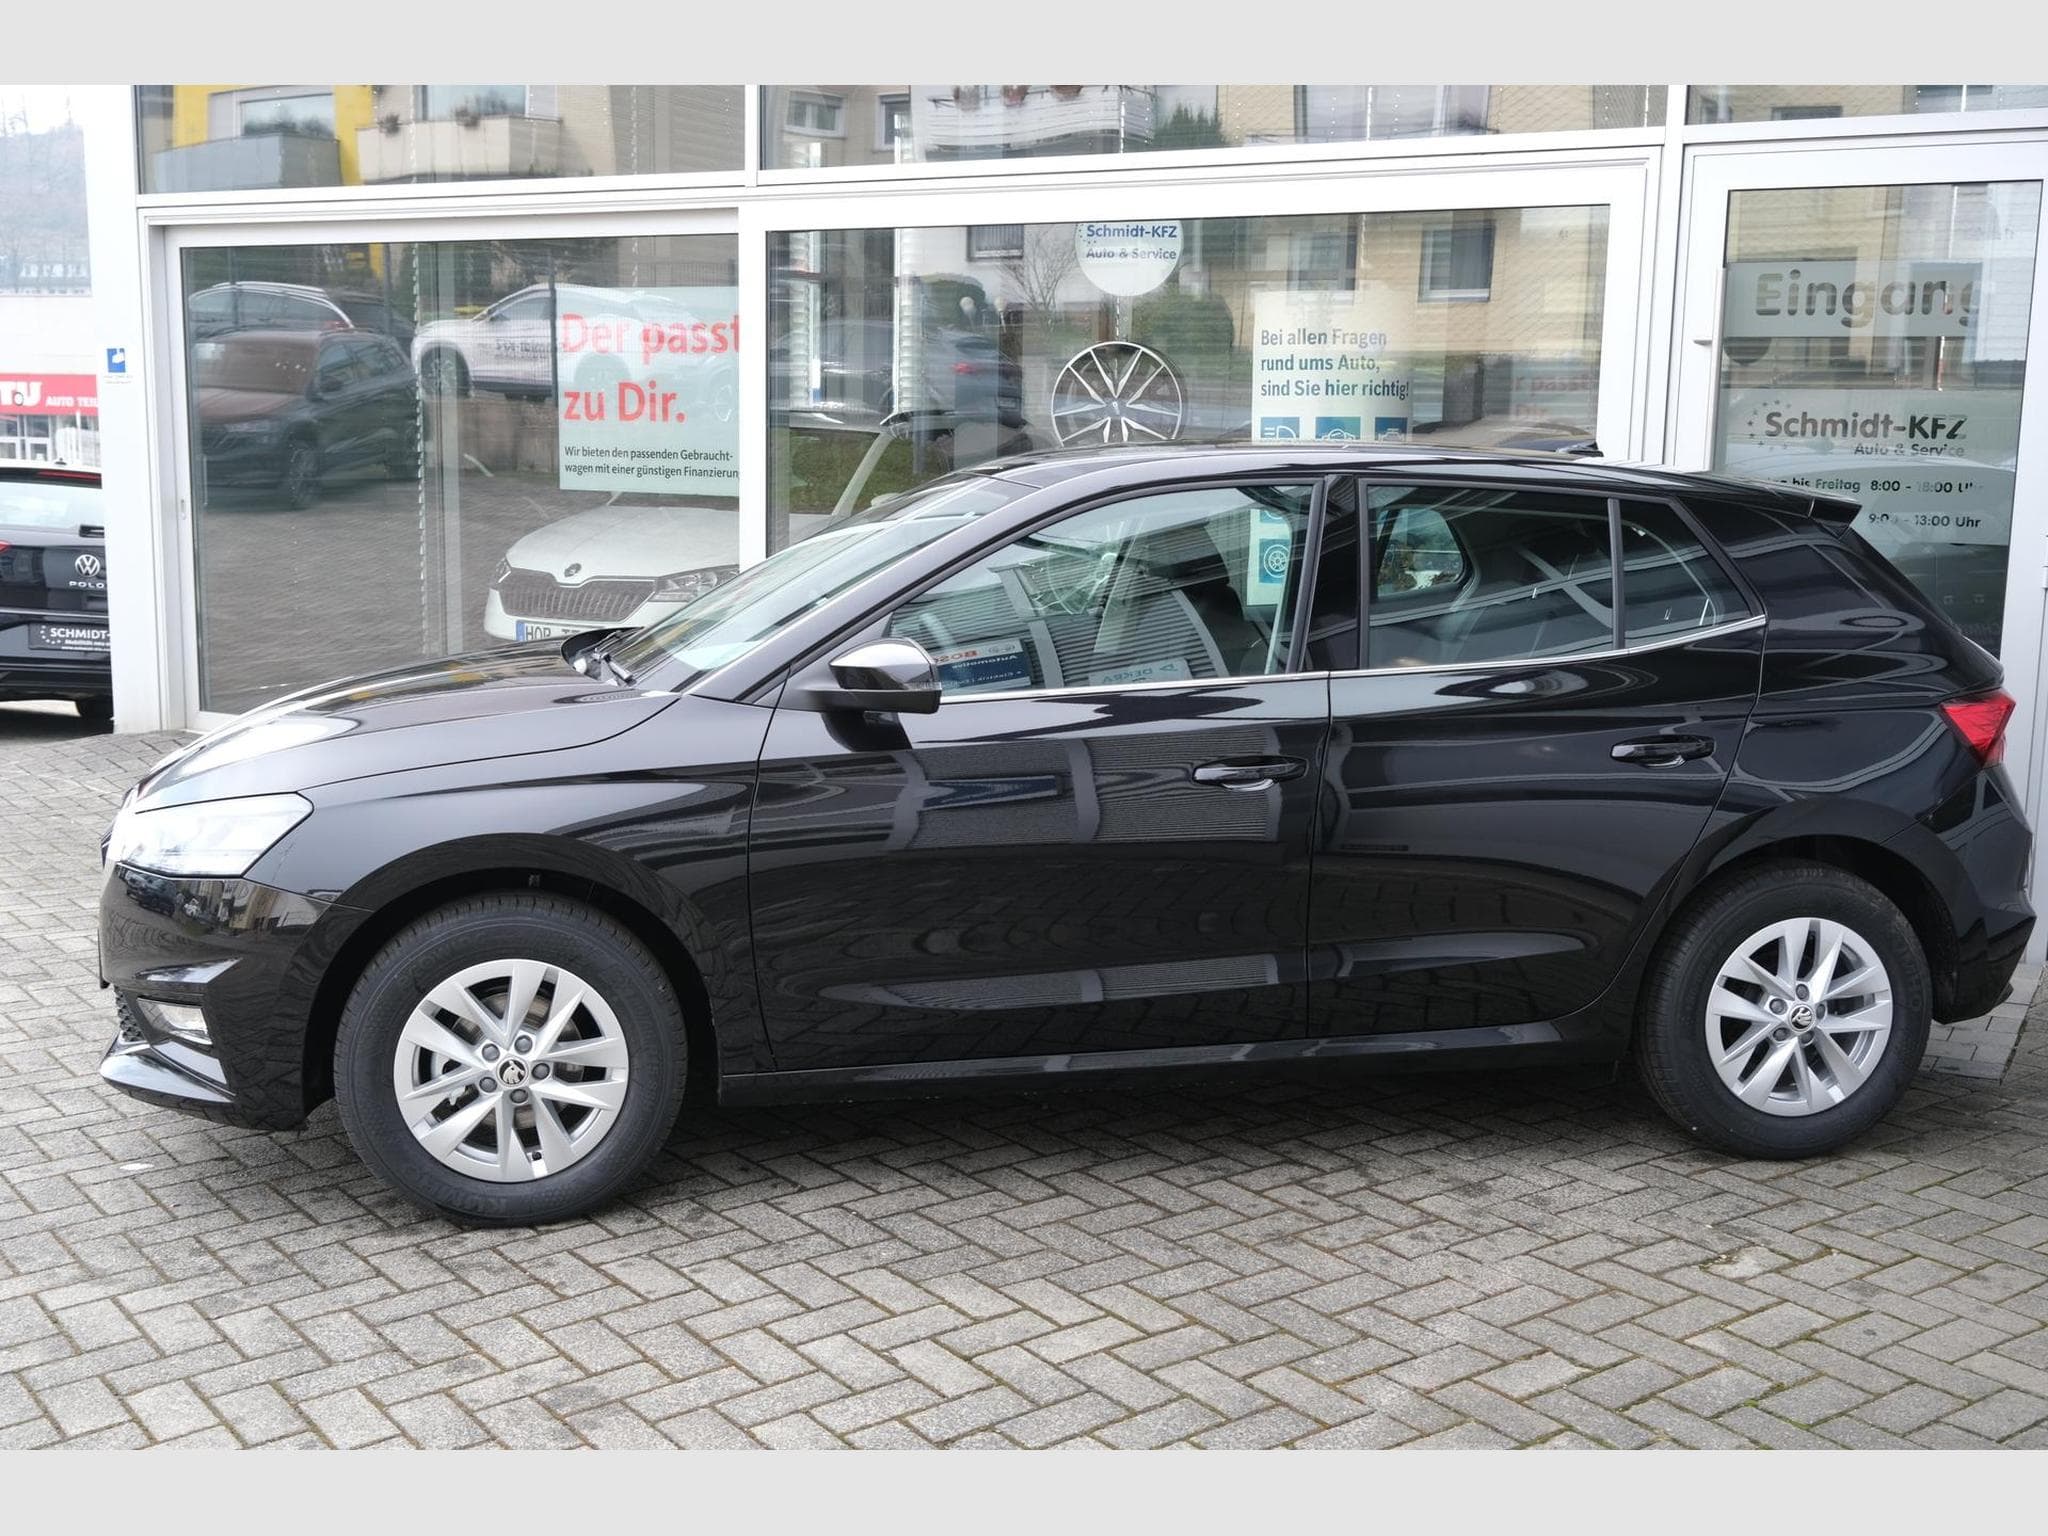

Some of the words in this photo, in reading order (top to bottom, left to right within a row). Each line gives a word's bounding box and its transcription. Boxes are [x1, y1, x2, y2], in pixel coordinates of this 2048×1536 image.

[1086, 224, 1178, 238] Schmidt-KFZ
[1086, 248, 1115, 259] Auto
[1119, 248, 1128, 258] &
[1131, 247, 1177, 260] Service
[562, 313, 629, 354] Der
[1261, 329, 1283, 346] Bei
[1287, 328, 1328, 346] allen
[1331, 329, 1388, 348] Fragen
[1261, 354, 1295, 371] rund
[1299, 358, 1334, 371] ums
[1337, 354, 1381, 373] Auto,
[1260, 379, 1290, 397] sind
[1294, 379, 1321, 397] Sie
[1325, 379, 1360, 397] hier
[1362, 380, 1410, 401] richtig!
[563, 390, 606, 421] zu
[617, 379, 687, 423] Dir.
[1764, 411, 1969, 440] Schmidt-KFZ
[564, 446, 582, 457] Wir
[582, 446, 611, 458] bieten
[611, 447, 630, 459] den
[630, 448, 679, 461] passenden
[680, 449, 734, 462] Gebraucht-
[1853, 443, 1889, 456] Auto
[1910, 443, 1966, 457] Service
[564, 465, 594, 477] wagen
[594, 463, 611, 474] mit
[611, 464, 635, 475] einer
[636, 464, 682, 479] günstigen
[1815, 478, 1861, 493] Freitag
[1870, 479, 1901, 492] 8:00
[1915, 515, 1950, 527] 13:00
[1955, 516, 1982, 528] Uhr
[68, 580, 105, 589] POLO
